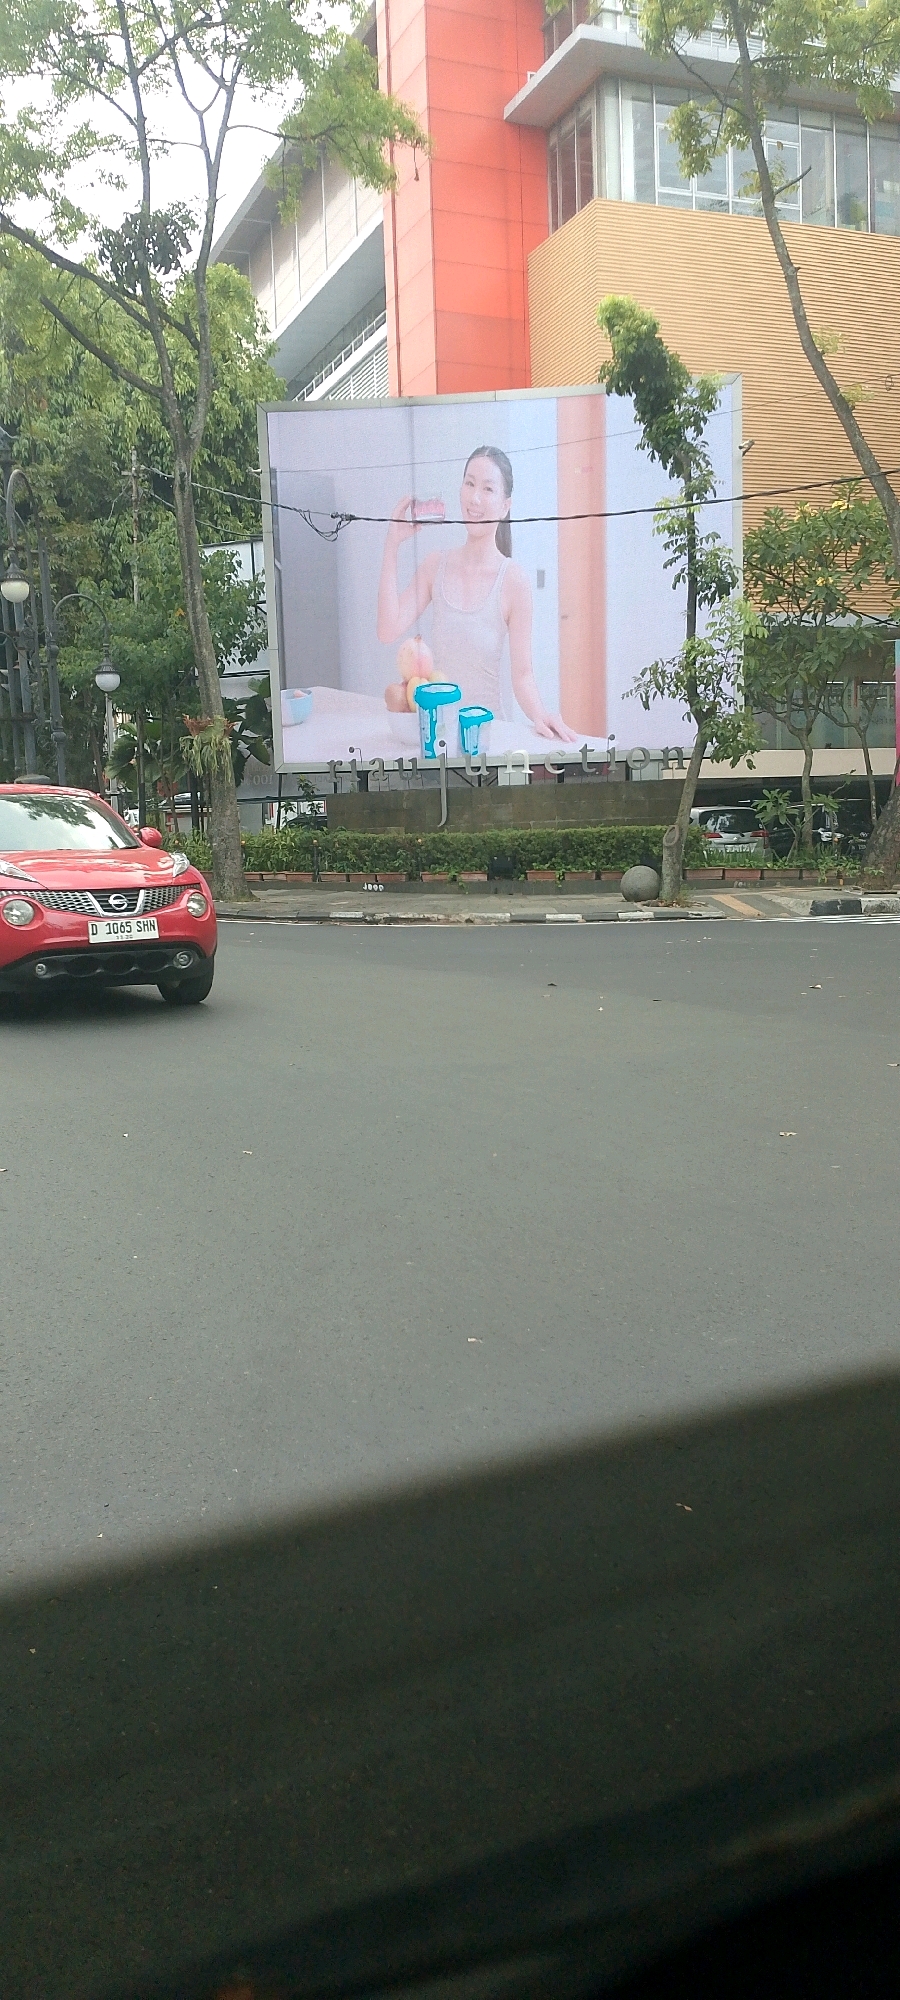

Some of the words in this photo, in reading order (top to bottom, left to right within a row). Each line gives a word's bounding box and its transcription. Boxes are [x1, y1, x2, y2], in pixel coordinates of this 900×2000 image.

[91, 923, 98, 936] D
[105, 921, 132, 935] 1065
[136, 920, 156, 933] SHN
